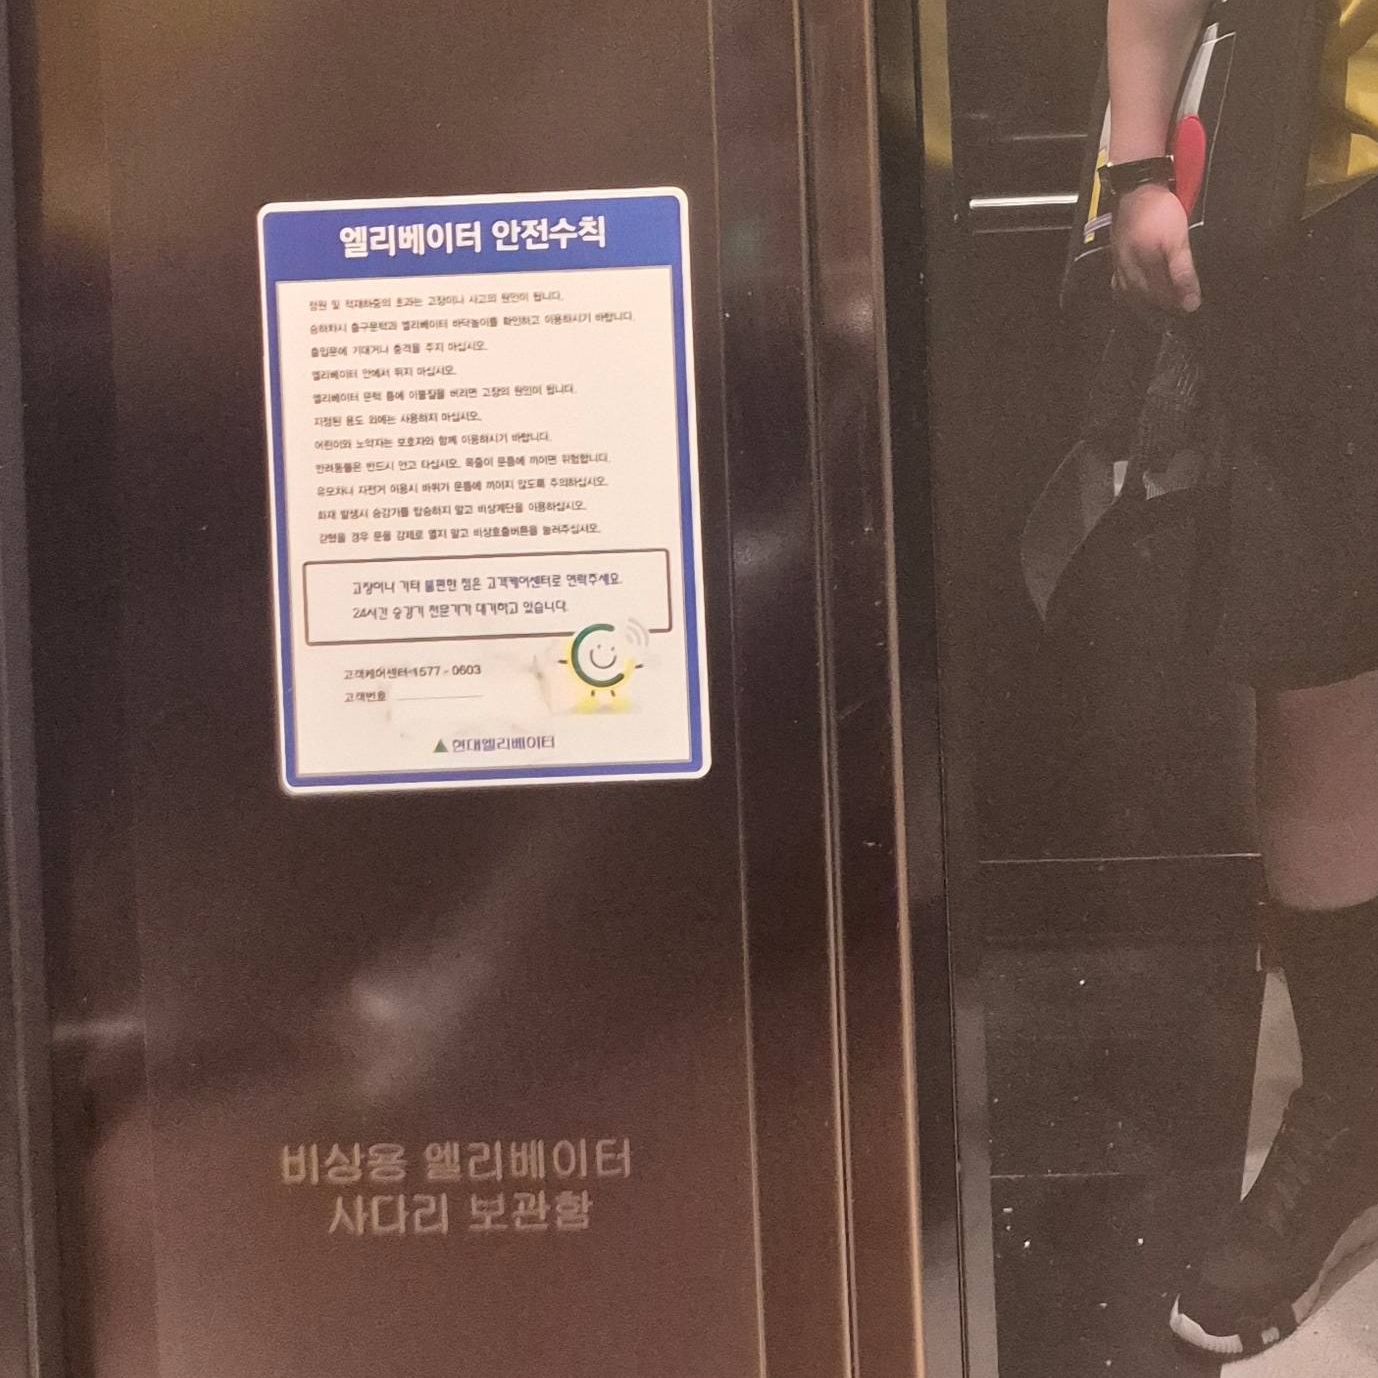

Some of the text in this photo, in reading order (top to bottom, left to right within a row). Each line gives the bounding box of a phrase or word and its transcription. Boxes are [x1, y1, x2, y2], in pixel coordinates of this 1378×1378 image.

[339, 216, 606, 259] 엘리베이터 안전수칙
[427, 294, 465, 306] 고장이나
[469, 293, 497, 304] 사고의
[501, 291, 529, 304] 원인이
[402, 319, 448, 331] 엘리베이터
[503, 315, 540, 327] 확인하고
[544, 313, 591, 325] 이용하시기
[311, 346, 347, 358] 출입문에
[352, 344, 389, 356] 기대거나
[394, 343, 421, 354] 충격을
[425, 341, 444, 353] 주지
[311, 369, 358, 381] 엘리베이터
[362, 367, 390, 379] 안에서
[312, 392, 359, 404] 엘리베이터
[409, 389, 445, 401] 이물질을
[450, 387, 478, 399] 버리면
[482, 386, 510, 398] 고장의
[514, 384, 543, 397] 원인이
[314, 415, 342, 427] 지정된
[346, 415, 365, 426] 용도
[369, 414, 397, 425] 외에는
[400, 412, 438, 424] 사용하지
[314, 439, 352, 451] 어린이와
[356, 437, 393, 449] 노약자는
[397, 436, 434, 448] 보호자와
[438, 435, 457, 446] 함께
[461, 433, 508, 445] 이용하시기
[366, 460, 394, 472] 반드시
[398, 460, 417, 471] 안고
[529, 454, 558, 466] 끼이면
[317, 485, 354, 497] 유모차나
[358, 484, 386, 496] 자전거
[390, 483, 418, 495] 이용시
[486, 480, 514, 491] 끼이지
[318, 510, 336, 520] 화재
[340, 508, 369, 520] 발생시
[372, 507, 409, 519] 승강기를
[455, 504, 473, 516] 말고
[478, 501, 524, 515] 비상계단을
[352, 531, 369, 543] 경우
[397, 529, 424, 541] 강제로
[451, 528, 469, 540] 말고
[400, 579, 421, 593] 기타
[425, 579, 457, 593] 불편한
[461, 578, 482, 591] 점은
[487, 574, 562, 589] 고객케어센터로
[352, 606, 389, 620] 24시간
[392, 605, 425, 620] 승강기
[476, 601, 519, 616] 대기하고
[451, 664, 482, 676] 0603
[343, 690, 387, 703] 고객번호
[452, 735, 555, 753] 현대엘리베이터
[281, 1137, 632, 1186] 비상용 엘리베이터
[329, 1189, 593, 1235] 사다리 보관함
